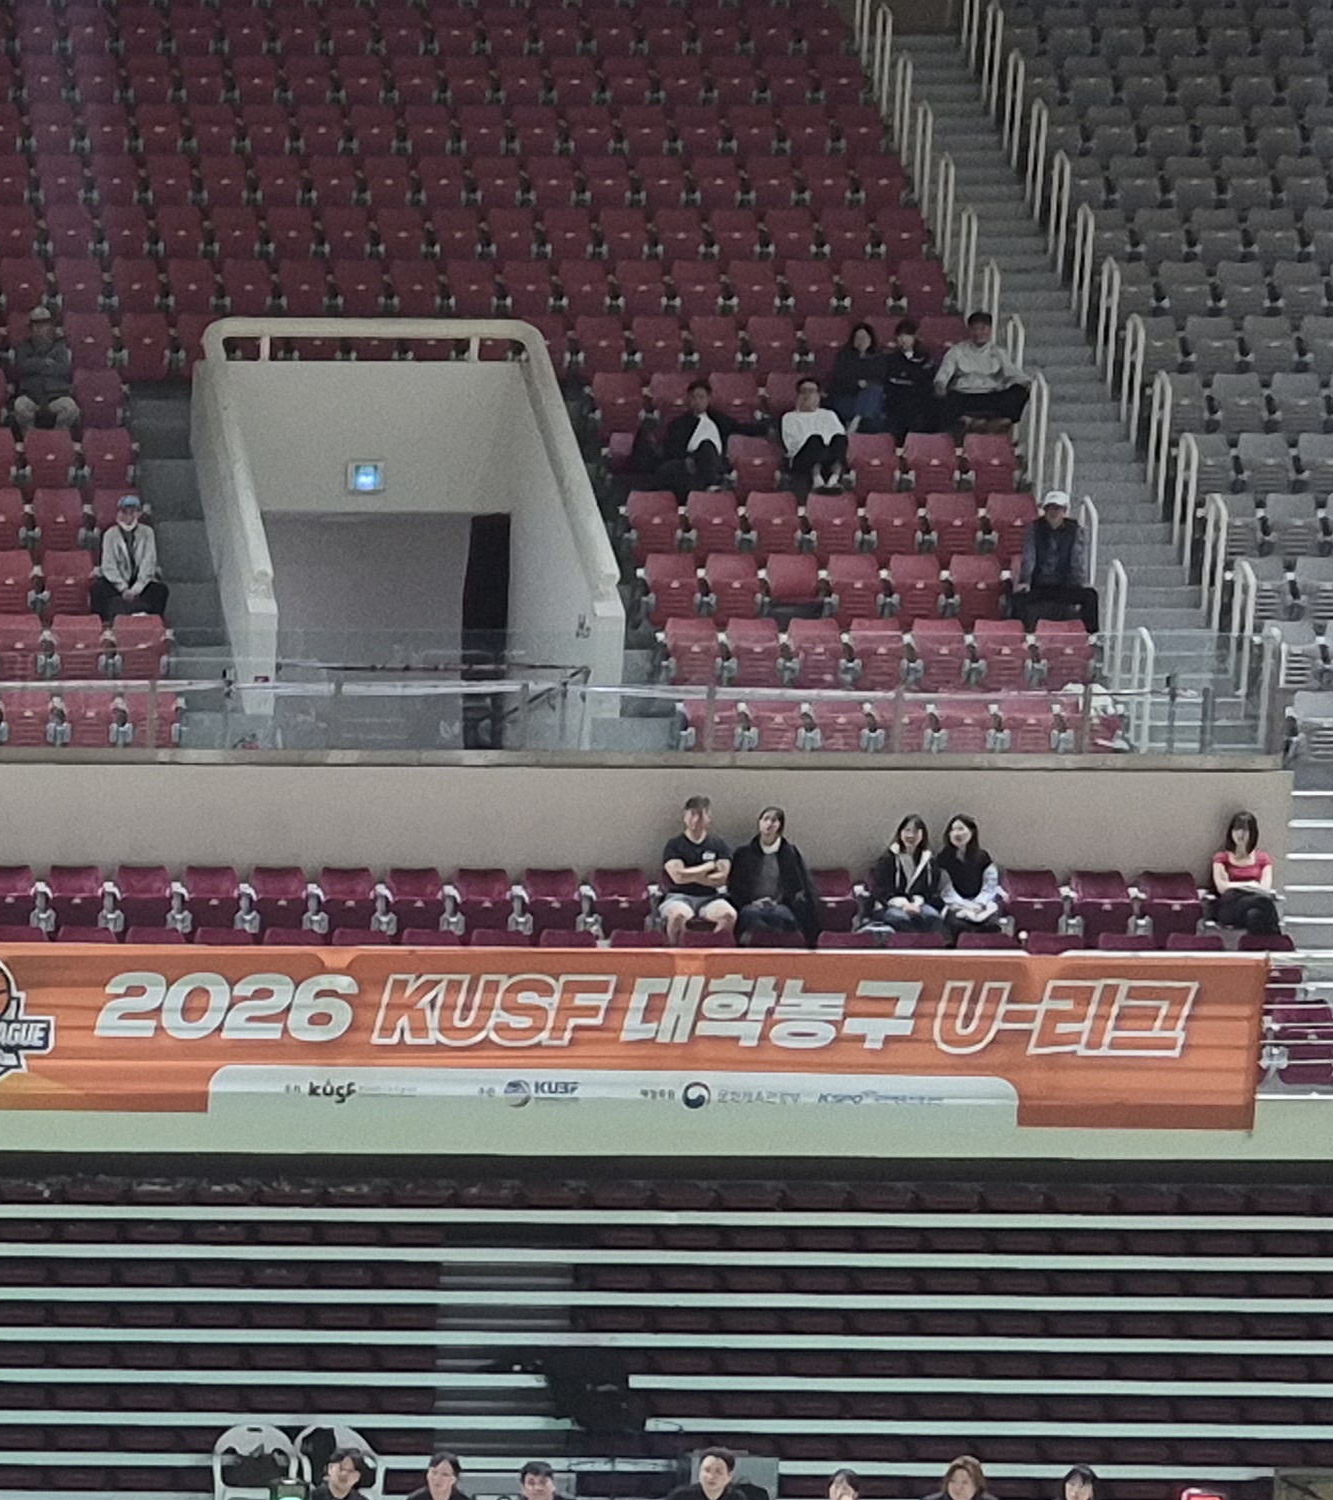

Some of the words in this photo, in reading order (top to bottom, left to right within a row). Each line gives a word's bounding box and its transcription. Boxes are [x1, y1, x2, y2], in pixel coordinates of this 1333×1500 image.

[94, 971, 359, 1041] 2026
[370, 974, 616, 1048] KUSF
[619, 974, 924, 1050] 대학농구
[933, 979, 1199, 1058] U-리그
